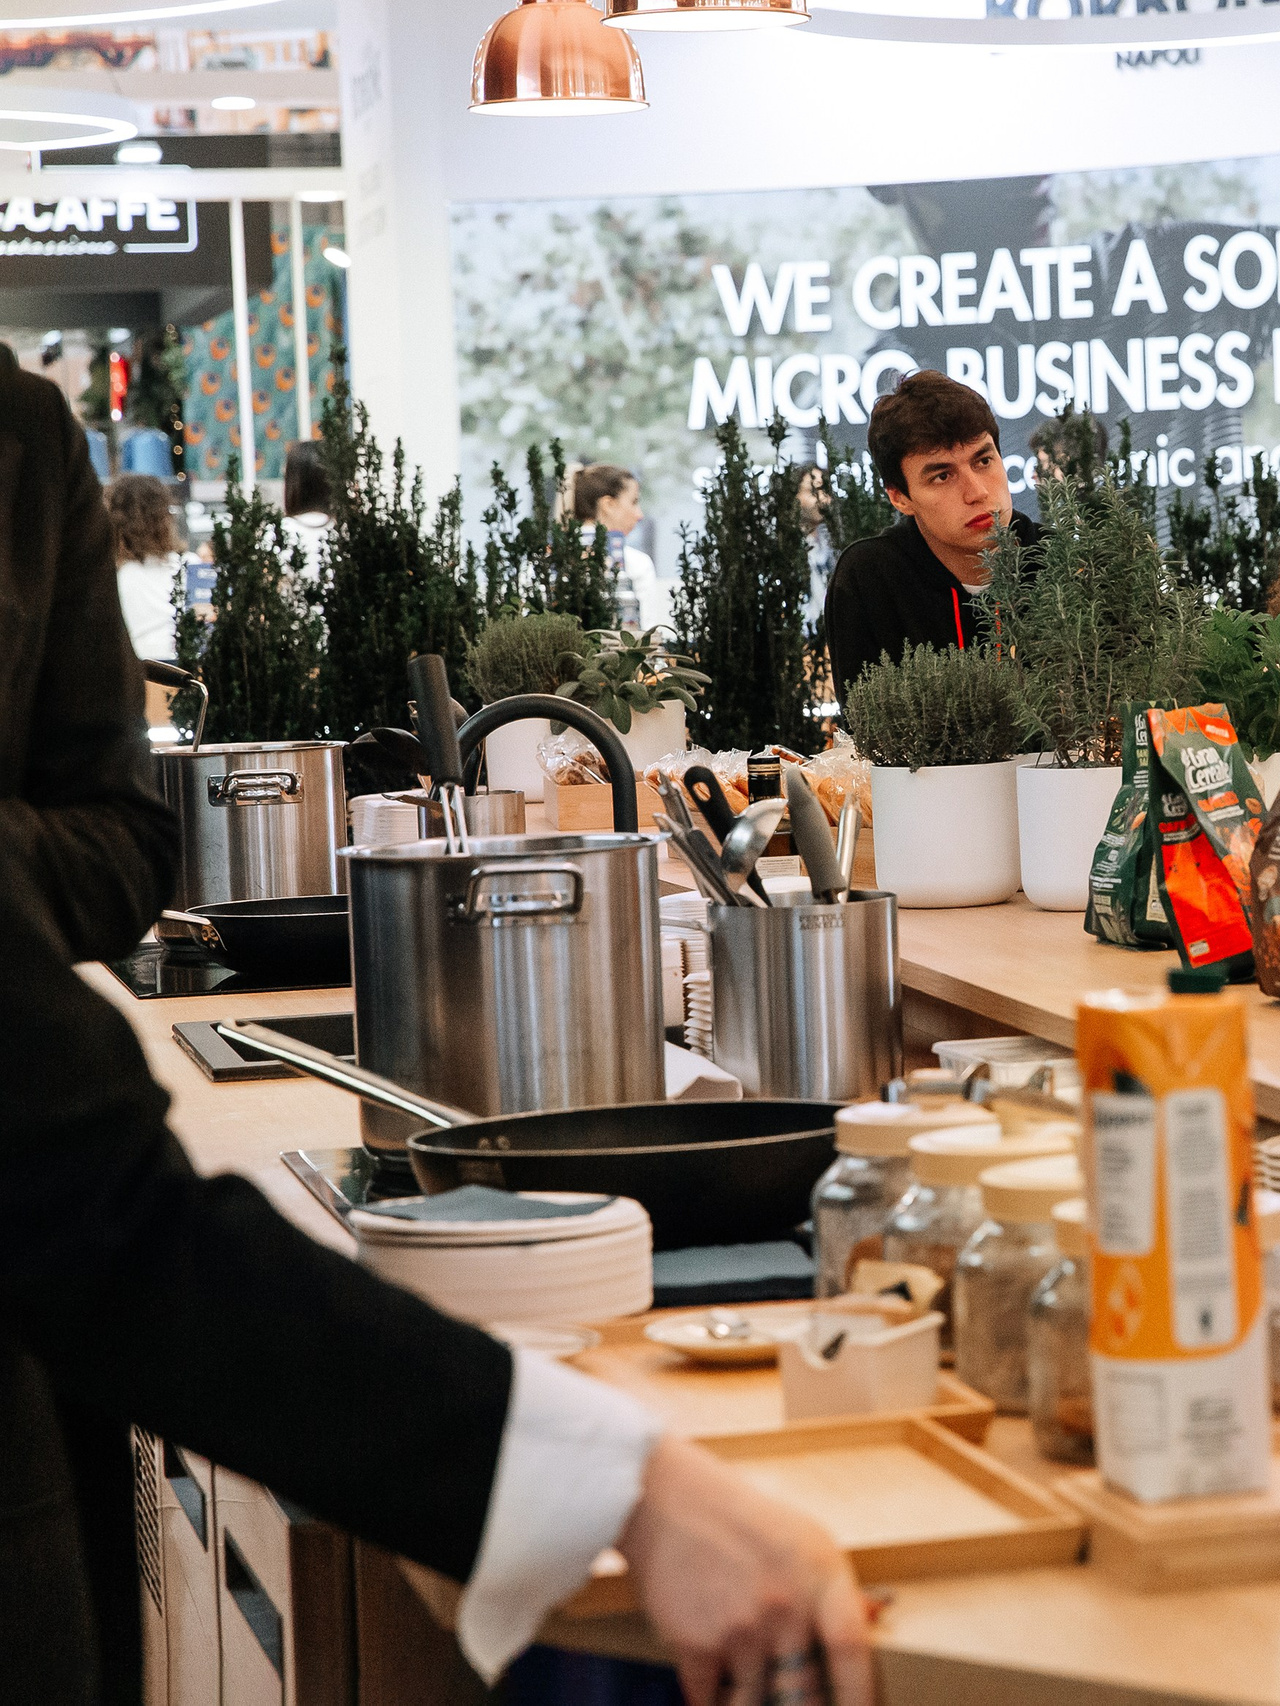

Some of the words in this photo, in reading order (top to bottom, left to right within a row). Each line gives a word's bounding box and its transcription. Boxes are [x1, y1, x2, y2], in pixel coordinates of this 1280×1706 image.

[711, 260, 832, 336] WE
[852, 244, 1094, 330] CREATE
[1111, 238, 1168, 316] A
[946, 330, 1255, 419] BUSINESS
